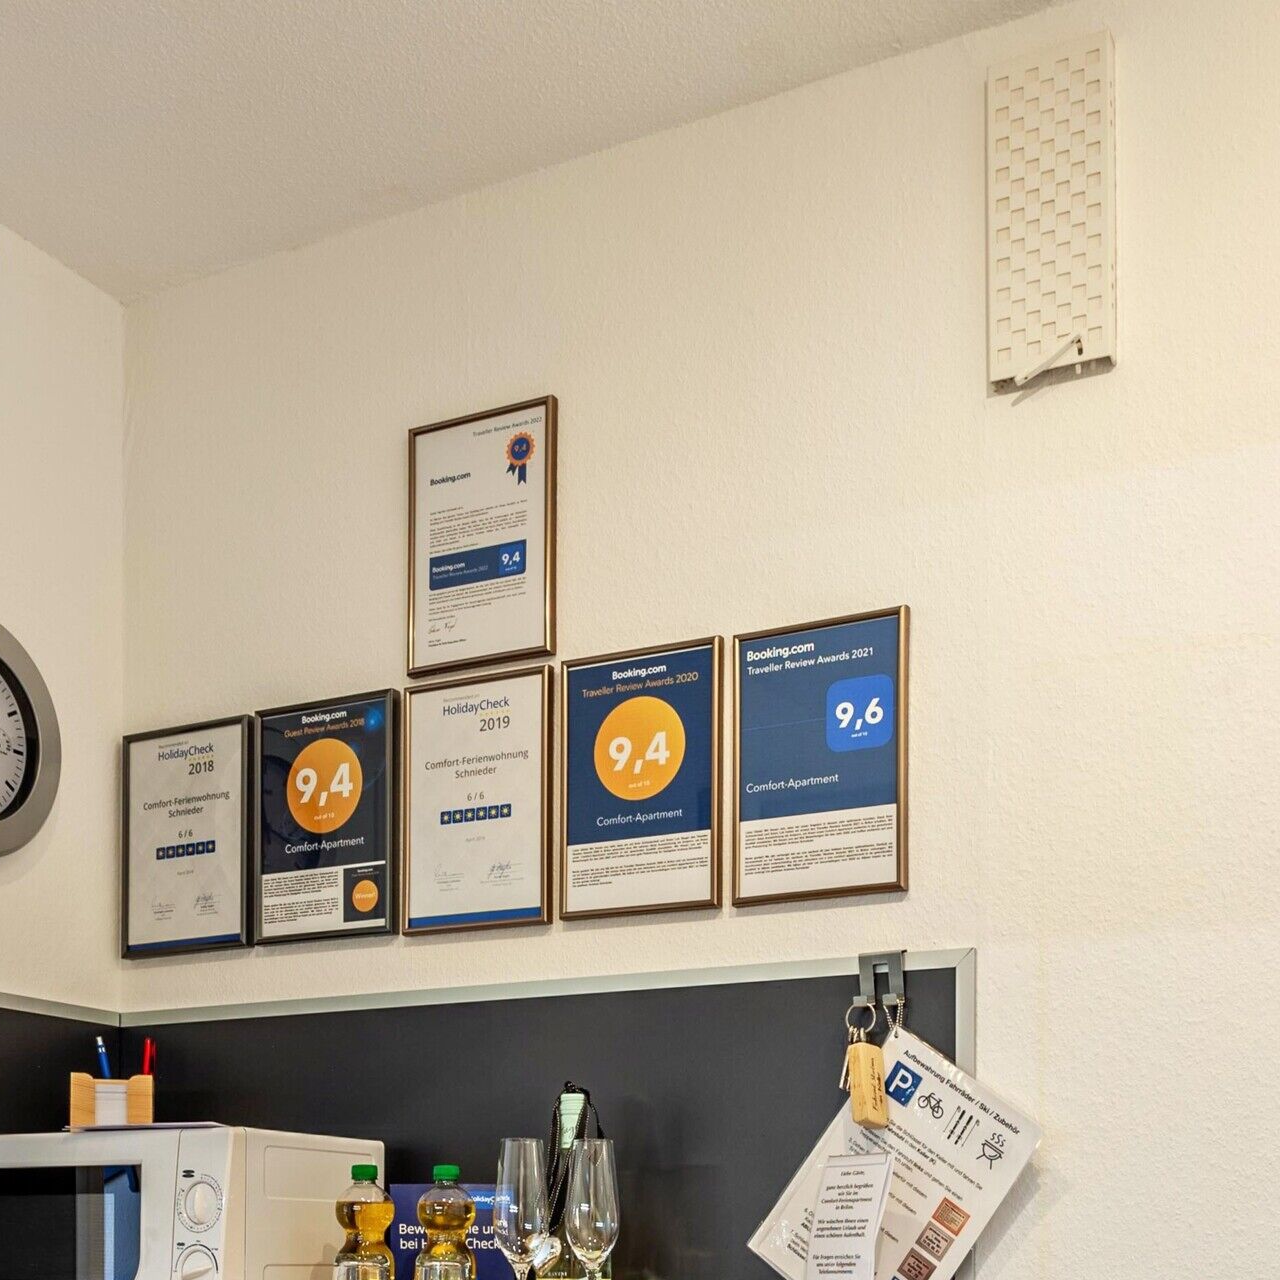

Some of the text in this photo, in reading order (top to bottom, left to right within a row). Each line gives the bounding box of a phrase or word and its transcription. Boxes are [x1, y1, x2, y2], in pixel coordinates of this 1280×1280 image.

[494, 425, 511, 433] Review
[512, 421, 530, 429] Awards
[430, 472, 471, 486] Booking.com
[502, 551, 520, 566] 9,4
[432, 562, 465, 574] Booking.com
[746, 642, 815, 662] Booking.com
[747, 647, 874, 676] Traveller Review Awards 2021
[612, 664, 667, 680] Booking.com
[582, 671, 699, 699] Traveller Review Awards 2020
[443, 697, 509, 716] HolidayCheck
[835, 697, 884, 731] 9,6
[301, 710, 347, 724] Booking.com
[479, 716, 510, 732] 2019
[284, 729, 303, 738] Guest
[304, 725, 325, 735] Review
[326, 722, 348, 731] Awards
[158, 743, 214, 761] HolidayCheck
[425, 749, 529, 770] Comfort-Ferienwohnung
[609, 731, 670, 775] 9,4
[188, 760, 214, 775] 2018
[455, 766, 497, 779] Schnieder
[296, 763, 353, 807] 9,4
[746, 774, 839, 794] Comfort-Apartment
[143, 791, 230, 811] Comfort-Ferienwohnung
[467, 792, 485, 801] 6 / 6
[168, 806, 204, 818] Schnieder
[596, 809, 682, 826] Comfort-Apartment
[178, 830, 183, 838] 6
[188, 829, 193, 837] 6
[285, 836, 364, 854] Comfort-Apartment
[889, 1068, 913, 1093] P
[903, 1050, 945, 1084] Aufbewahrung
[945, 1079, 975, 1103] Fahrräder
[979, 1103, 990, 1115] Ski
[993, 1113, 1020, 1135] Zubehör
[400, 1238, 418, 1249] bei
